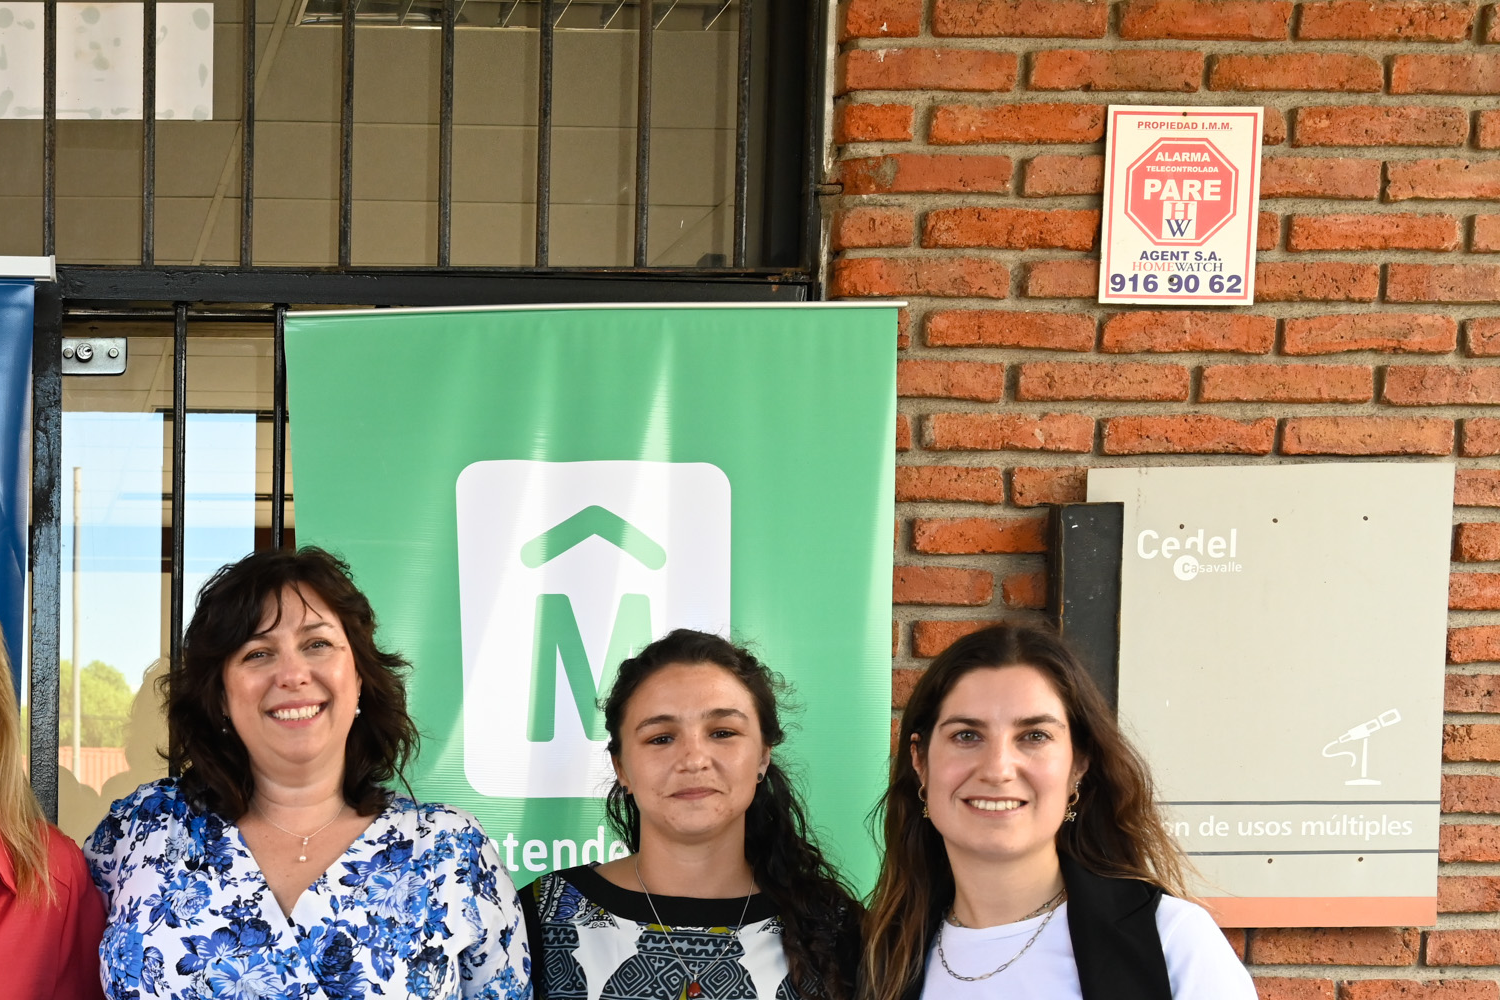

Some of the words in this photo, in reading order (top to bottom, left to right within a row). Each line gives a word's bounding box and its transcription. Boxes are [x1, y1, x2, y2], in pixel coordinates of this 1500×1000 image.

[1137, 121, 1198, 129] PROPIEDAD
[1201, 122, 1233, 130] I.M.M.
[1155, 152, 1210, 162] ALARMA
[1146, 165, 1219, 173] TELECONTROLADA
[1144, 179, 1222, 201] PARE
[1140, 251, 1190, 261] AGENT
[1194, 251, 1222, 261] S.A.
[1132, 262, 1223, 272] HOMEWATCH
[1110, 273, 1159, 293] 916
[1167, 274, 1200, 294] 90
[1208, 274, 1242, 294] 62
[1137, 528, 1238, 560] Cedel
[1181, 561, 1243, 574] Casavalle
[1198, 815, 1230, 838] de
[1237, 820, 1293, 838] usos
[1301, 814, 1414, 841] múltiples
